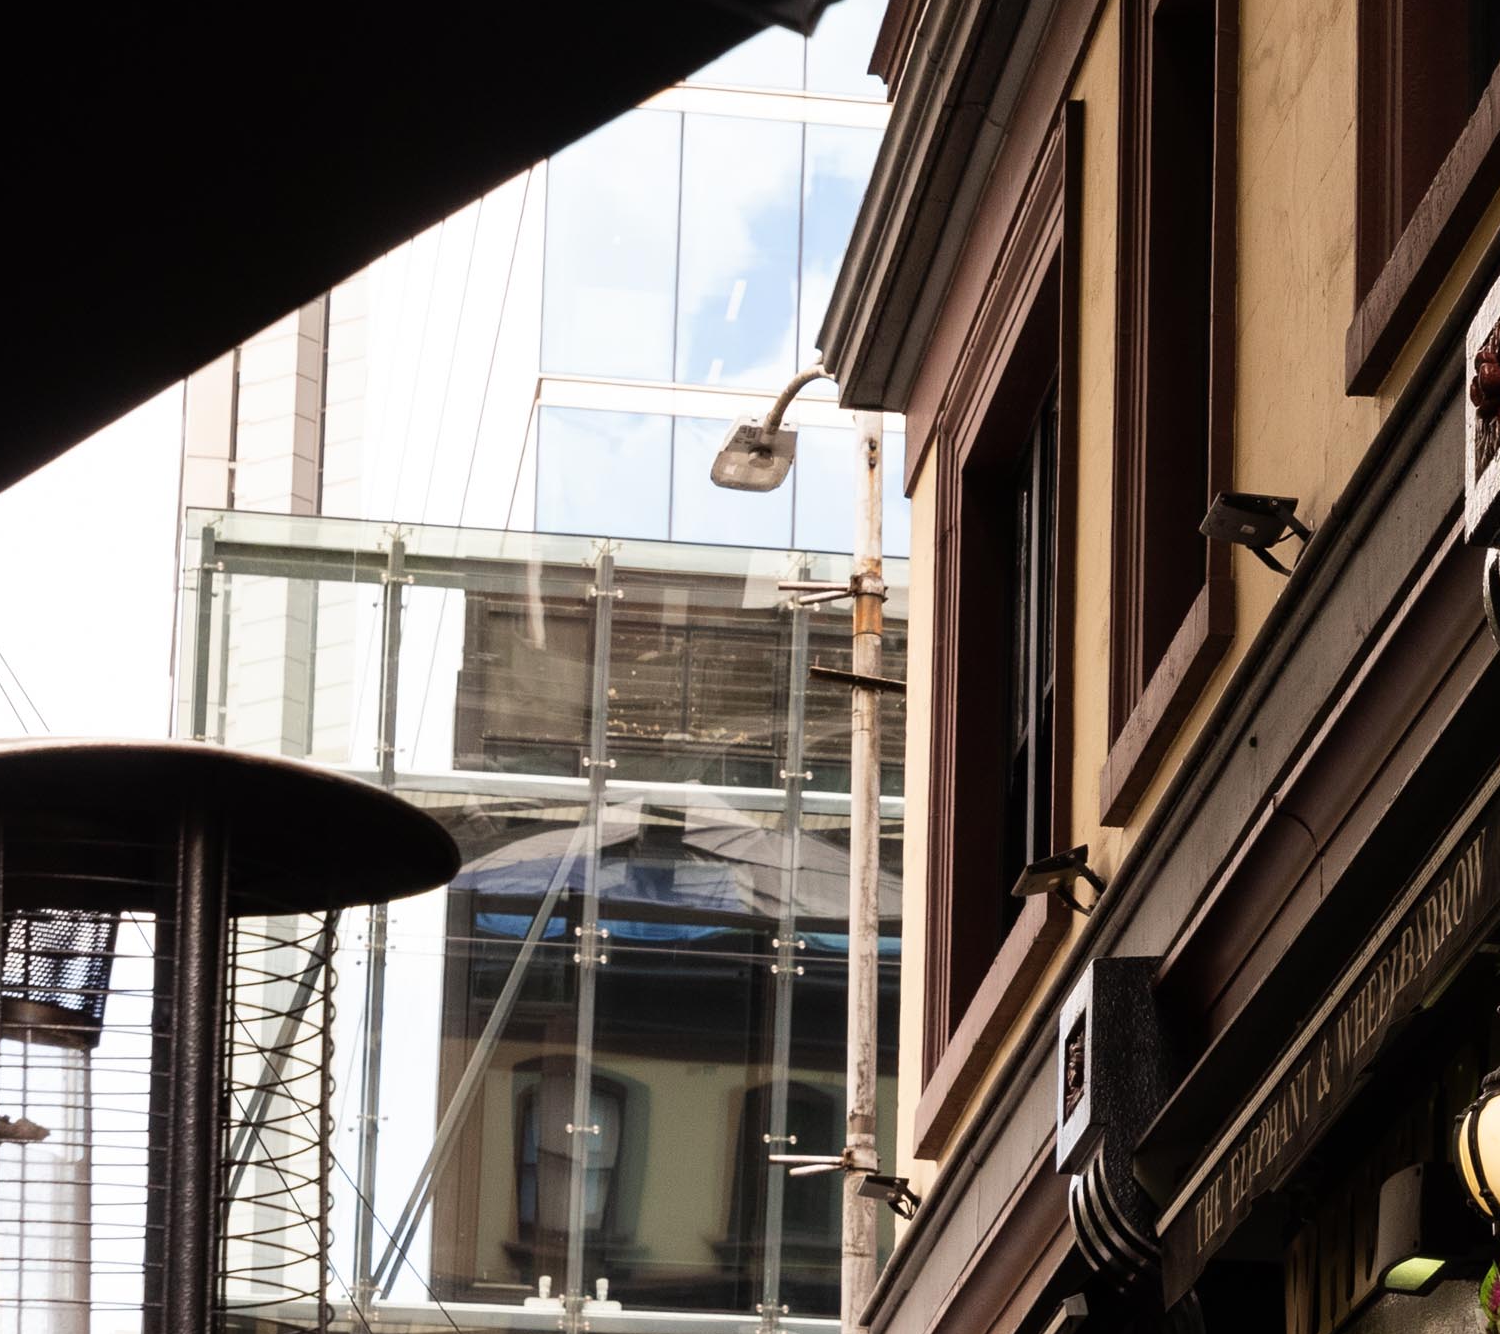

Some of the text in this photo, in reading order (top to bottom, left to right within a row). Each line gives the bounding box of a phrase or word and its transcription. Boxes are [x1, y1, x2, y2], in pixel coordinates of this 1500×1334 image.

[1196, 1182, 1225, 1256] THE
[1230, 1060, 1314, 1214] ELEPHANT
[1336, 826, 1490, 1075] WHEELBARROW
